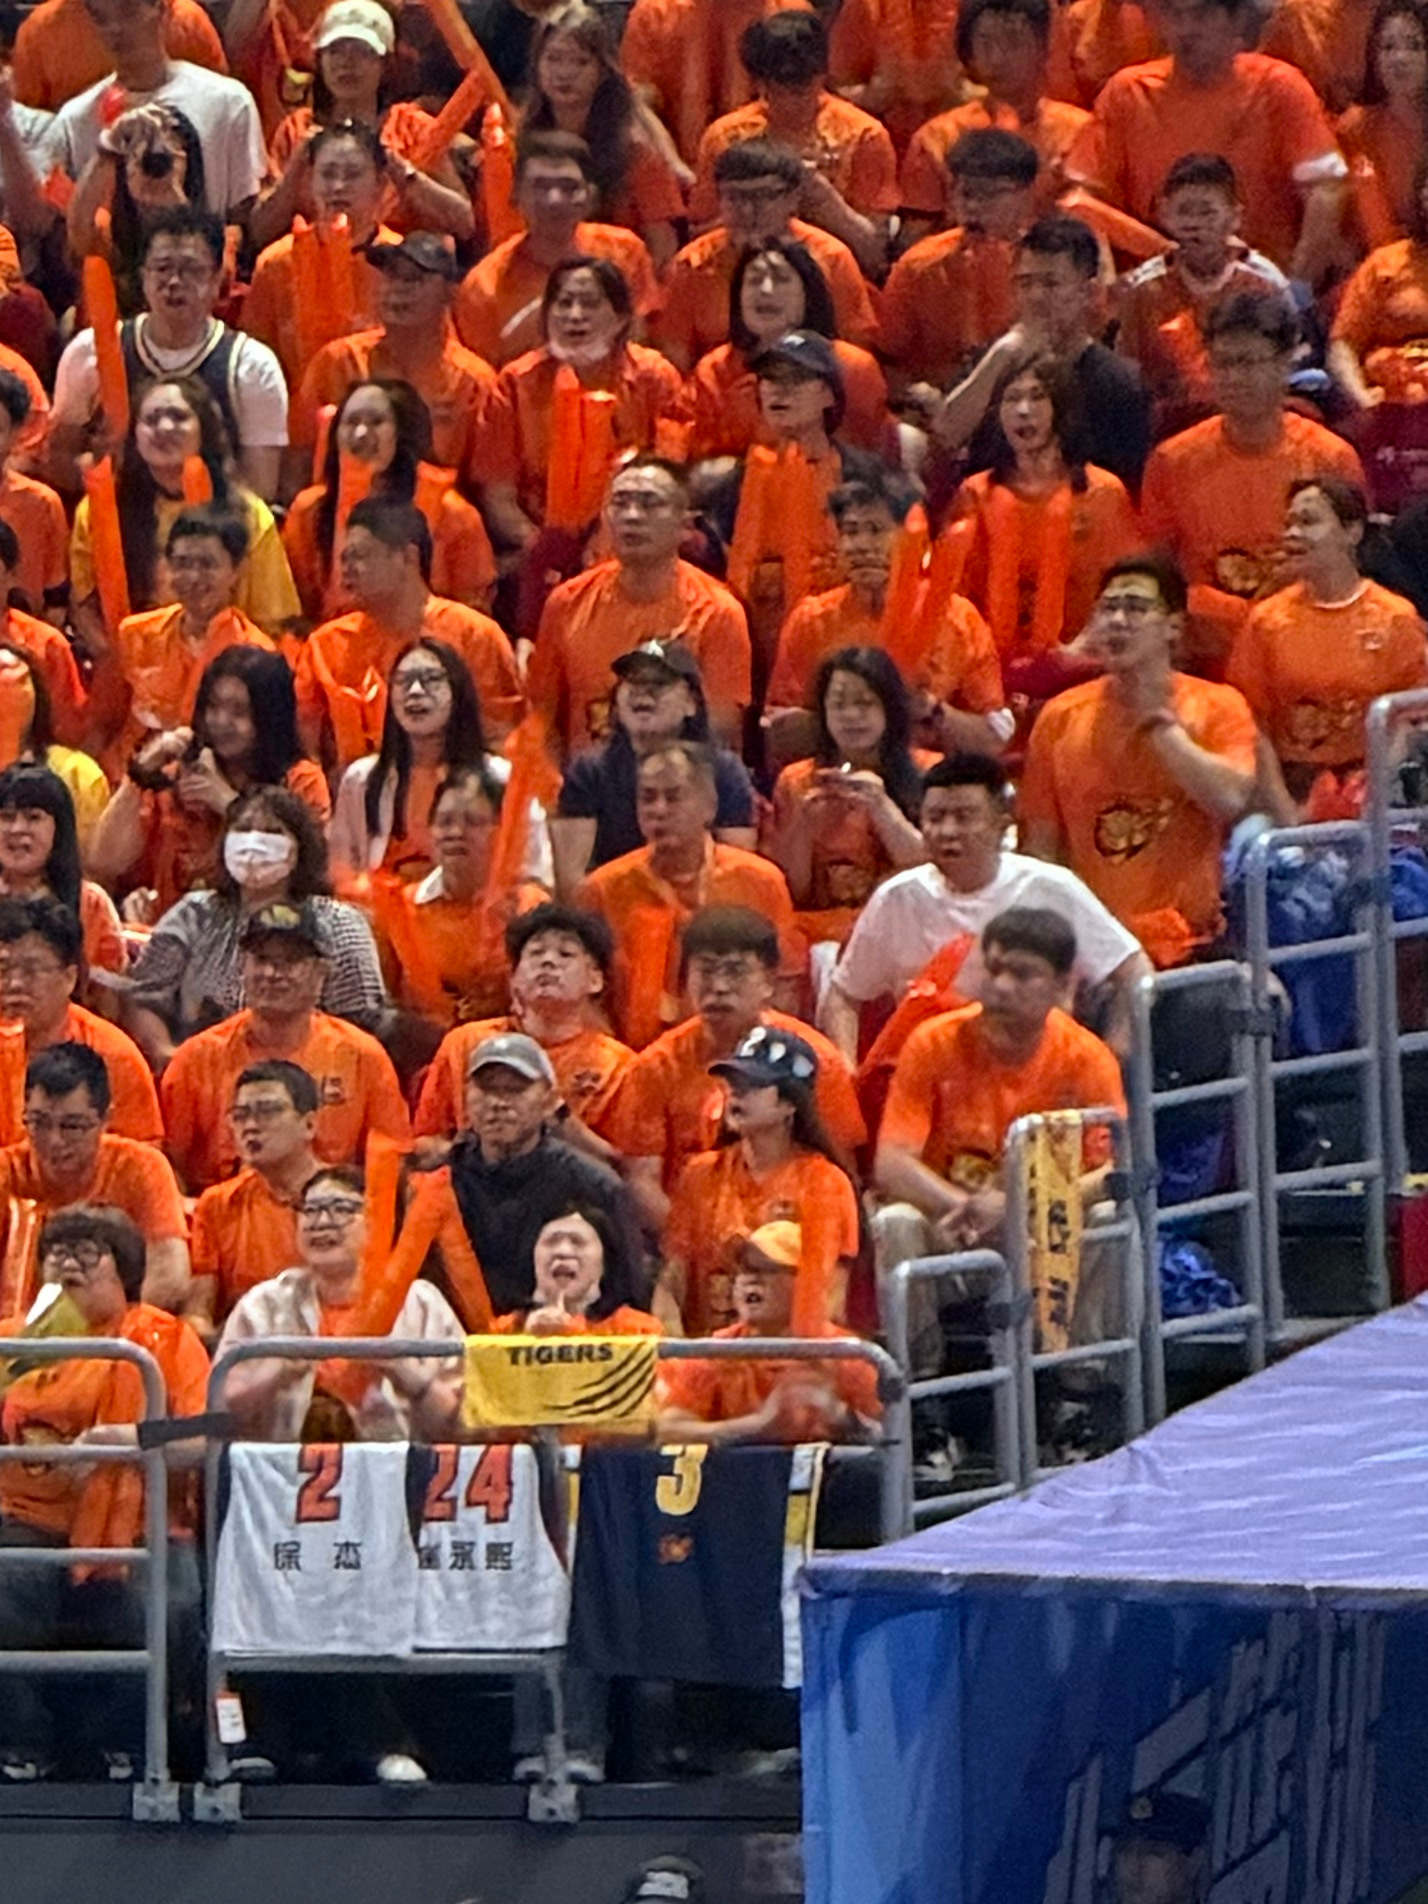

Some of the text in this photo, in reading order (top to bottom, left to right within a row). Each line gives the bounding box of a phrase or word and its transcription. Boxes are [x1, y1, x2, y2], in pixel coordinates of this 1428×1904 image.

[508, 1342, 614, 1368] TIGERS
[295, 1443, 344, 1523] 2
[423, 1444, 514, 1523] 24
